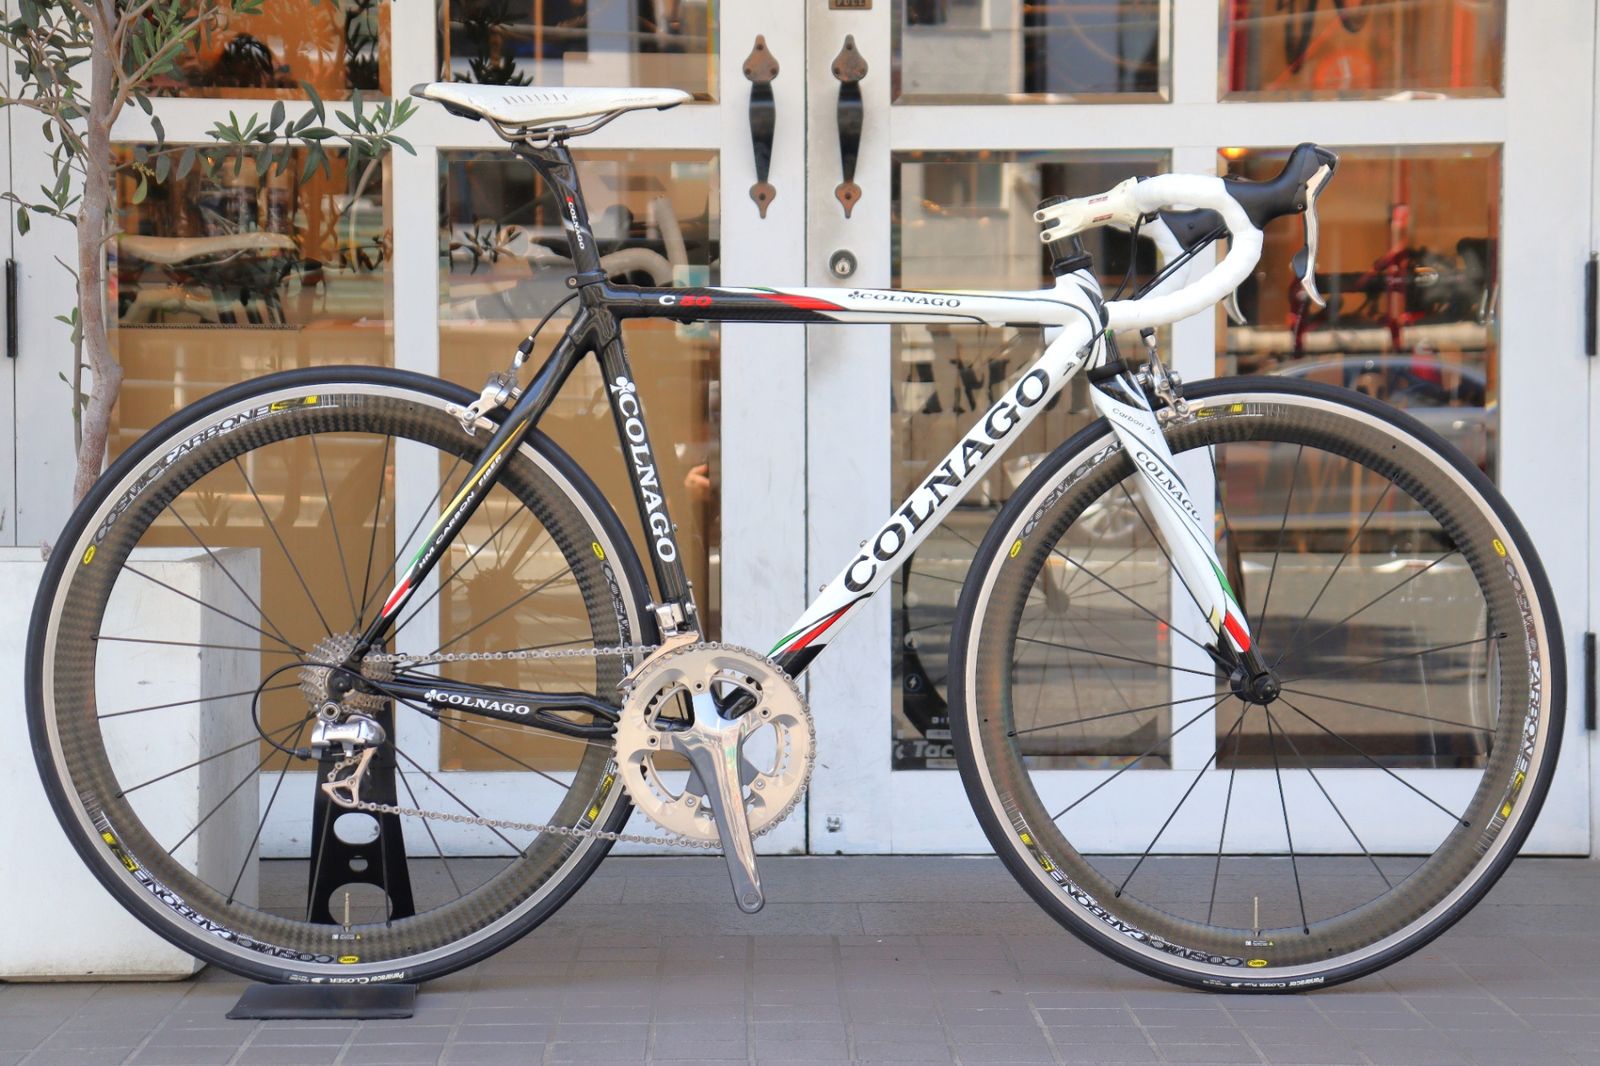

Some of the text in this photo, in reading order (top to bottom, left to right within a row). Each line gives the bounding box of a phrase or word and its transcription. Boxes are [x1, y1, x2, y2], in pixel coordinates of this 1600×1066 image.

[568, 202, 585, 250] COLNAGO
[859, 292, 961, 308] COLNAGO
[162, 403, 269, 467] CARBONE
[1112, 407, 1144, 429] Carbon
[618, 392, 677, 563] COLNAGO
[844, 368, 1051, 592] COLNAGO
[418, 453, 503, 569] HM CARBON FIBER
[436, 692, 531, 715] COLNAGO
[1519, 657, 1540, 773] CARBONE
[914, 740, 956, 758] Tac
[133, 867, 232, 940] CARBONE
[1051, 868, 1146, 942] CARBONE
[370, 971, 405, 983] Panaracer
